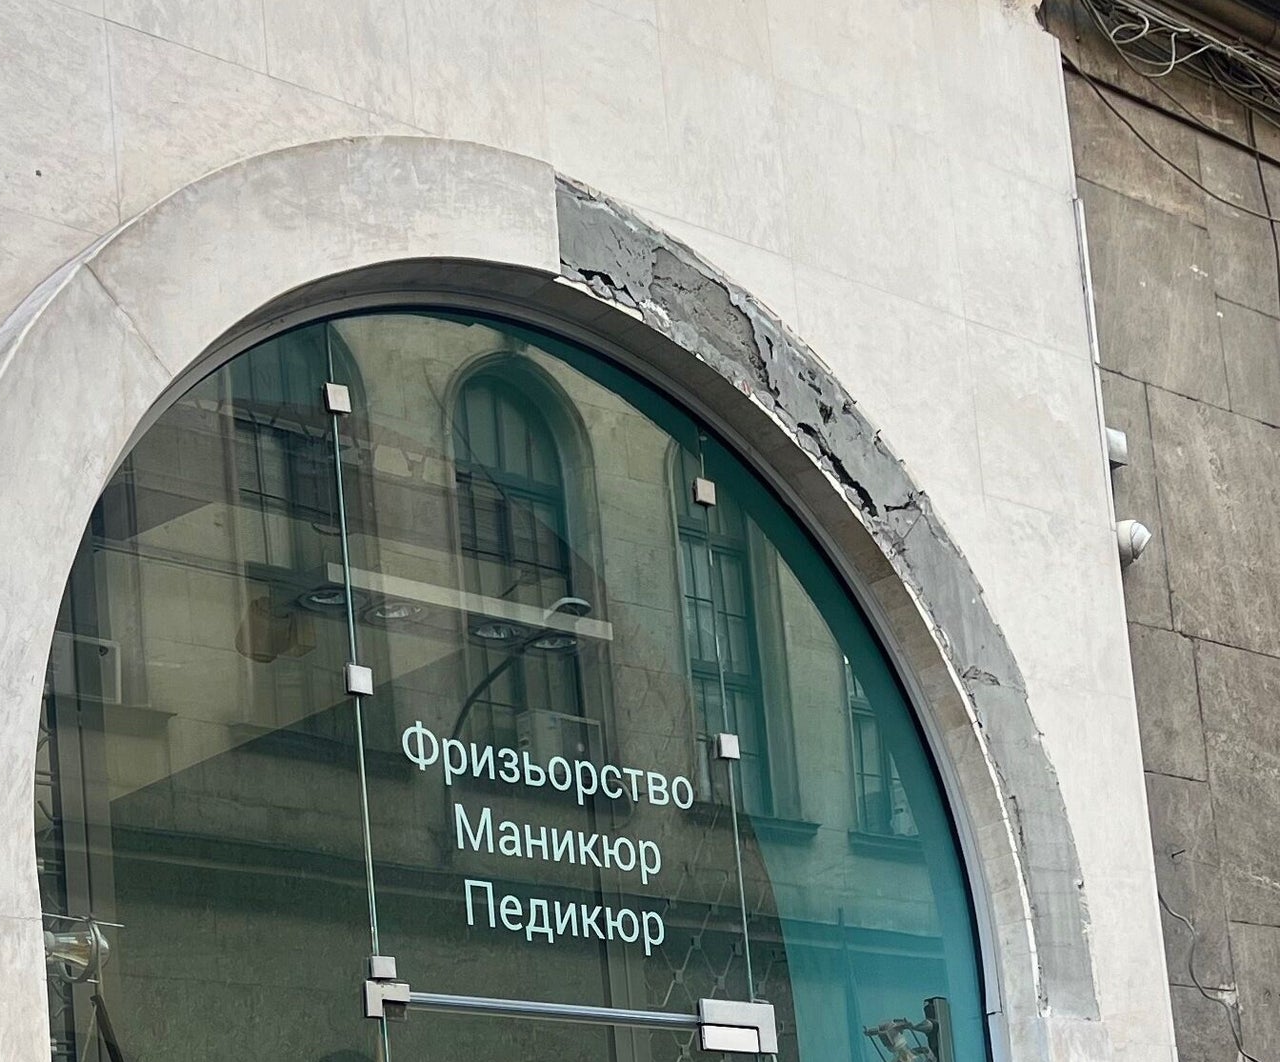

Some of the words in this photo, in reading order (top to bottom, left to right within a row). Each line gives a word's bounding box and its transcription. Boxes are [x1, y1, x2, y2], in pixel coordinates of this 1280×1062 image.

[401, 720, 695, 811] Фризьорство
[454, 802, 662, 885] Маникюр
[464, 878, 665, 957] Педикюр
